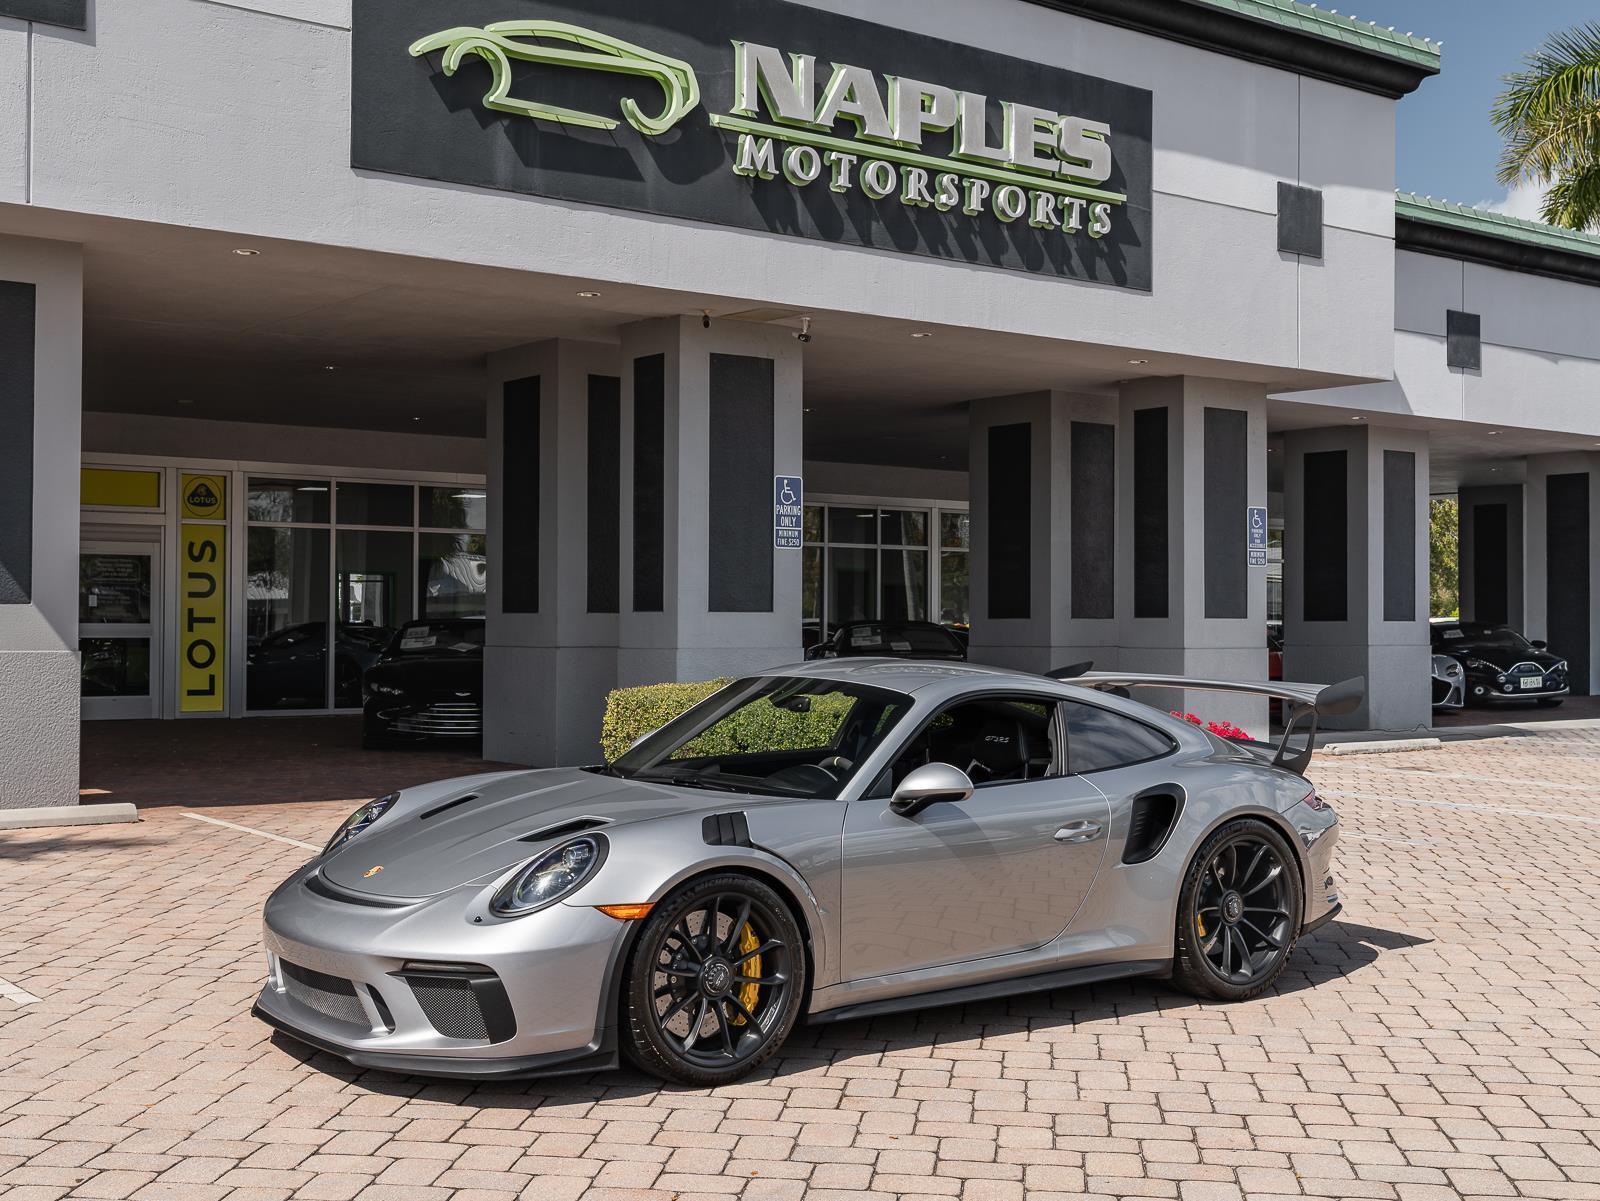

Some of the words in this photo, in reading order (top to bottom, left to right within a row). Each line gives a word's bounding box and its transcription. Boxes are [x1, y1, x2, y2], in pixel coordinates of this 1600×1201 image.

[730, 39, 1112, 182] NAPLES
[732, 134, 1112, 239] MOTORSPORTS
[189, 496, 217, 504] LOTUS
[776, 505, 801, 515] PARKING
[780, 517, 796, 527] ONLY
[187, 540, 217, 696] LOTUS
